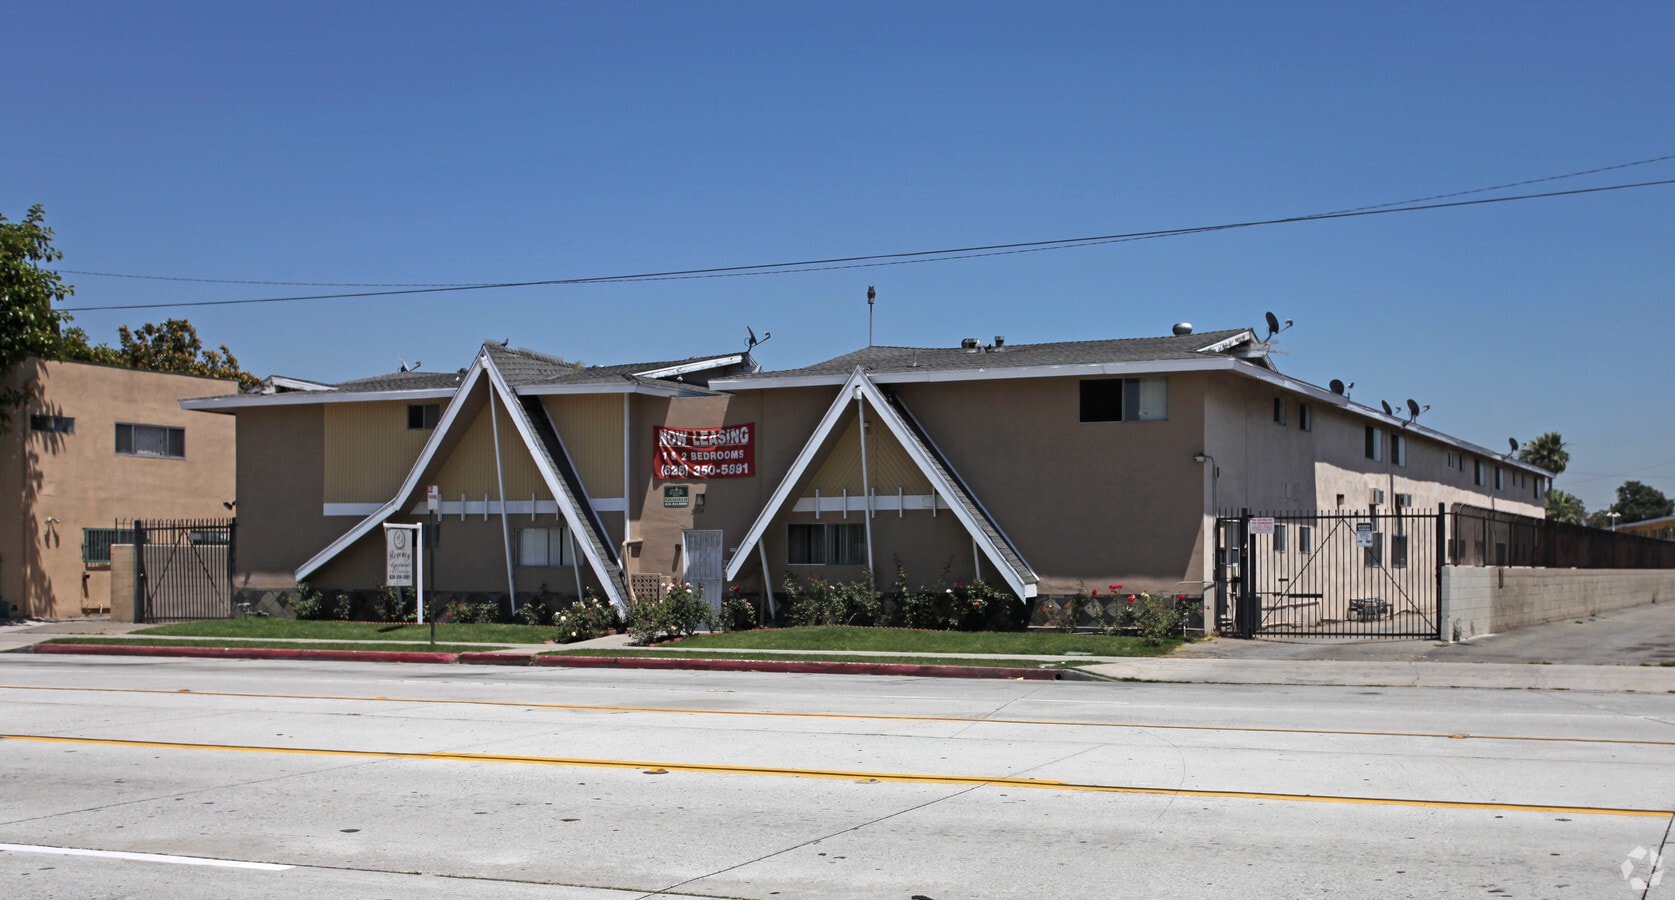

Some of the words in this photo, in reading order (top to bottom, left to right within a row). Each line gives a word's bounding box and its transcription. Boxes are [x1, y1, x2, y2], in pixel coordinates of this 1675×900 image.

[659, 429, 688, 446] NOW
[693, 426, 749, 446] LEASING
[662, 451, 667, 460] 1
[681, 451, 688, 461] 2
[690, 449, 745, 461] BEDROOMS
[661, 464, 688, 476] (626)
[693, 463, 749, 476] 350-5891
